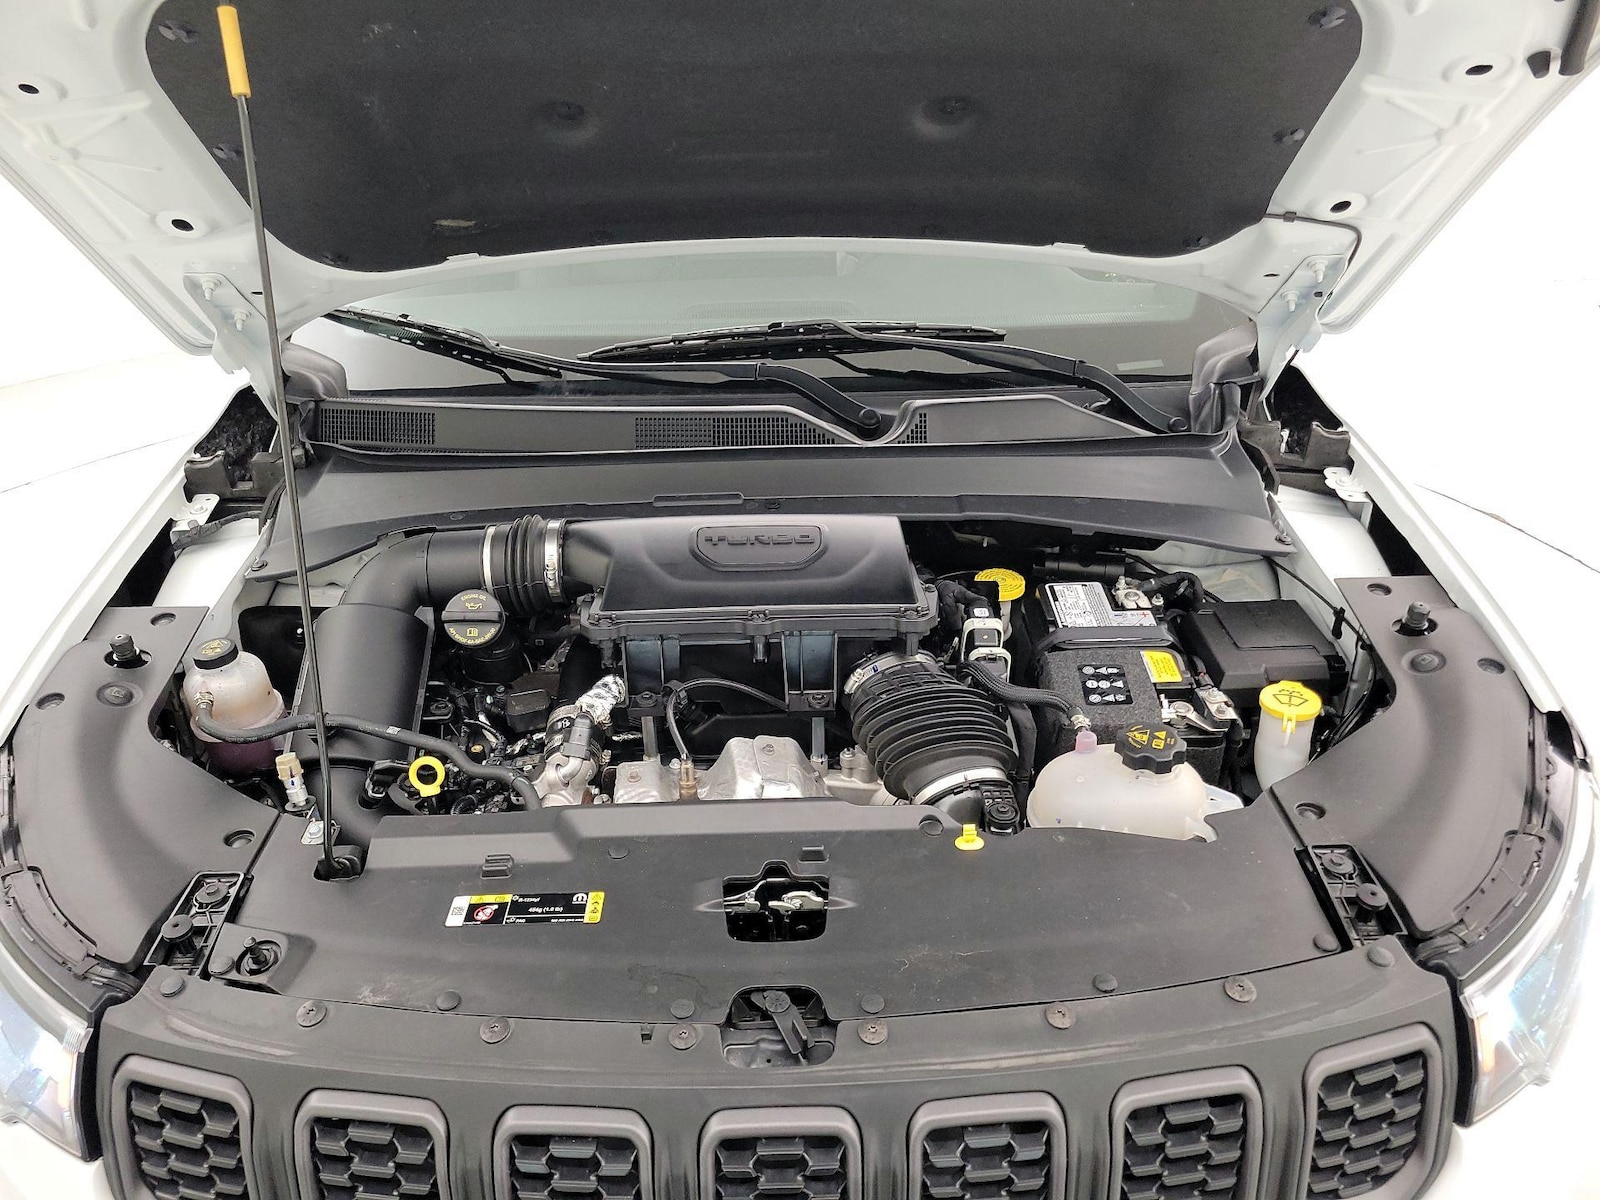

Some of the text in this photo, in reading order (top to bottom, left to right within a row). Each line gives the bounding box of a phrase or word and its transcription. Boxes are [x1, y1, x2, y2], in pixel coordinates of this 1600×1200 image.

[704, 533, 816, 547] TURBO
[460, 593, 487, 602] ENGINE OIL
